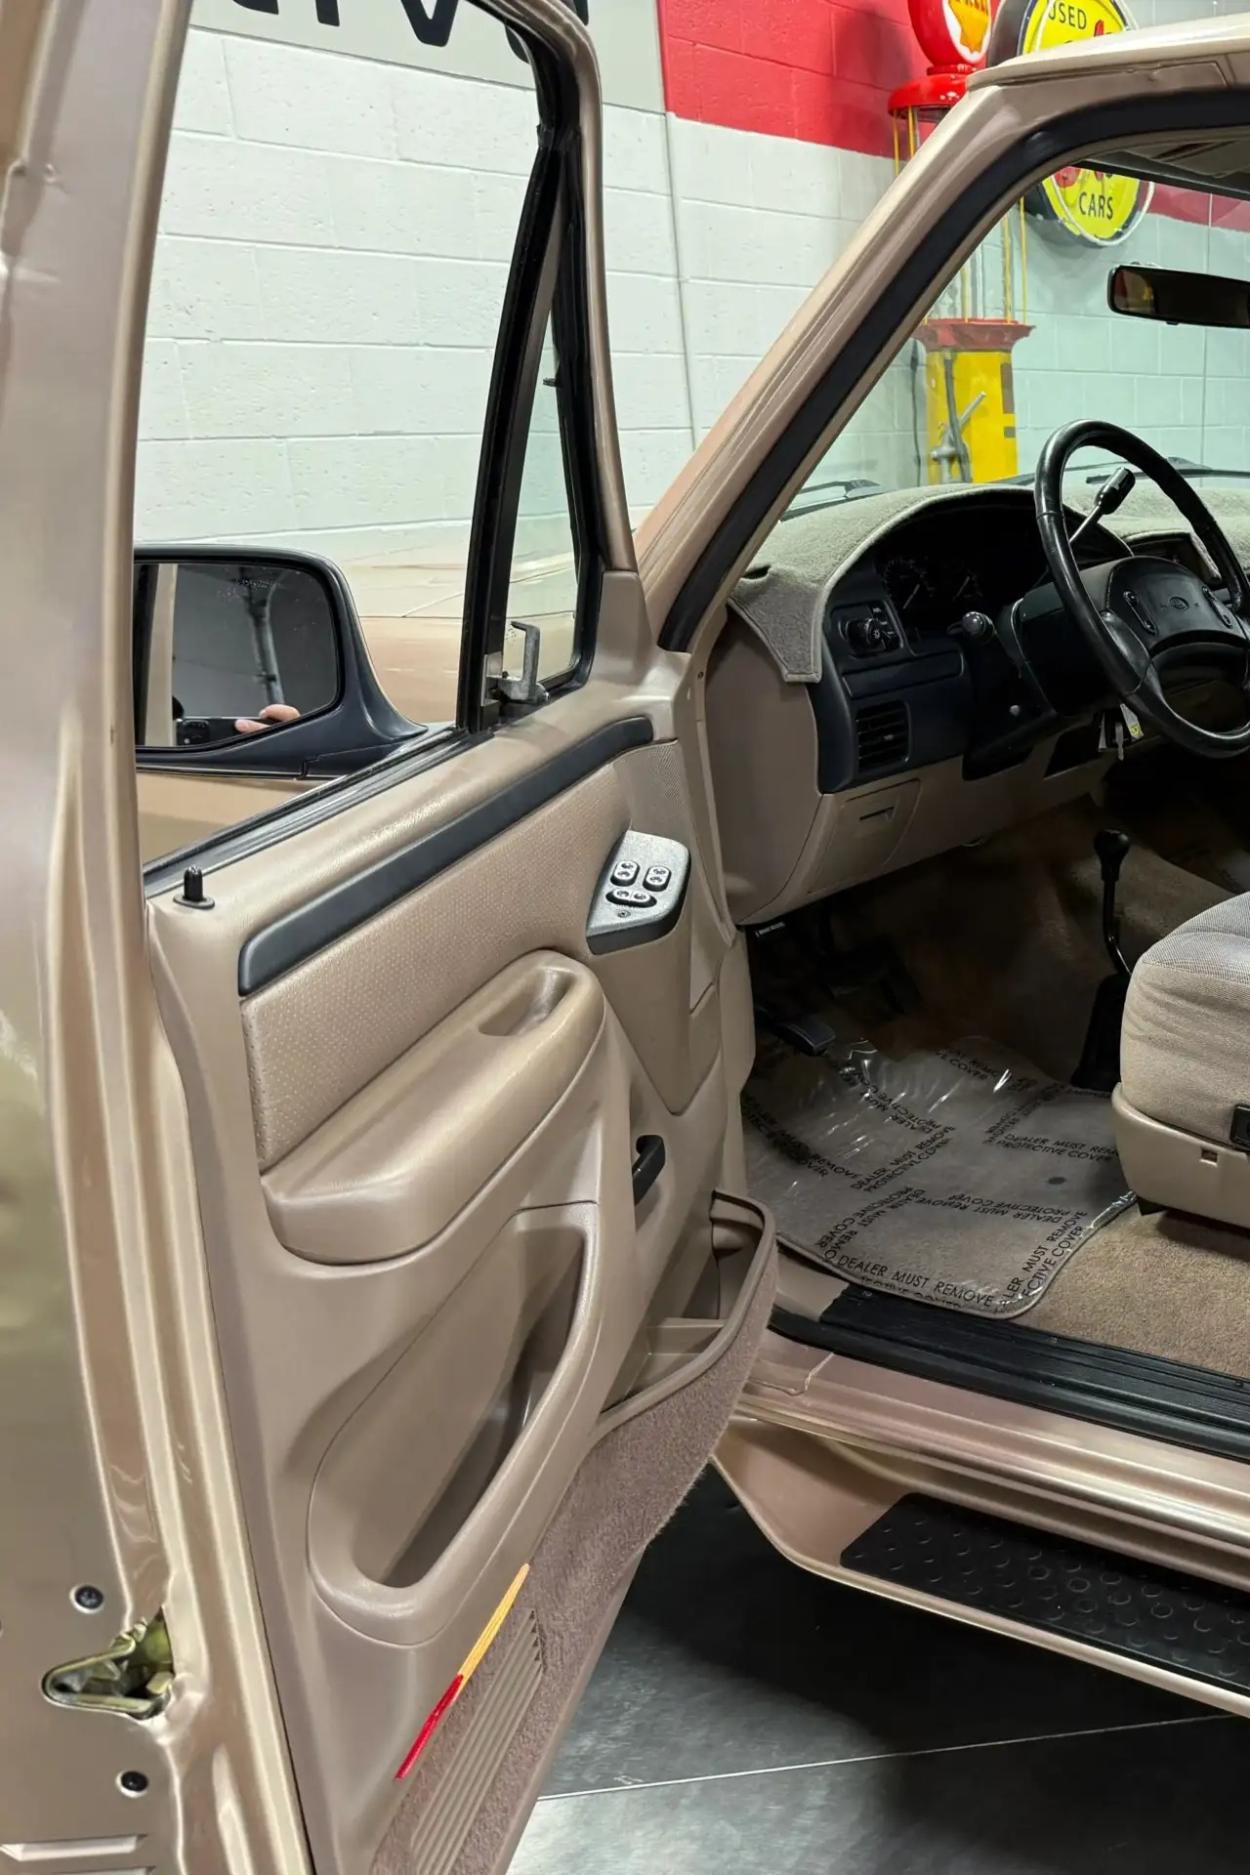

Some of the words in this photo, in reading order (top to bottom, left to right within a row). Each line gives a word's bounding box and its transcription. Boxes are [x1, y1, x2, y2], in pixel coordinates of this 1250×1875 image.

[1048, 0, 1086, 30] USED
[1079, 192, 1114, 220] CARS
[996, 1139, 1067, 1156] PROTECTIVE
[1003, 1133, 1049, 1145] DEALER
[1052, 1138, 1087, 1150] MUST
[849, 1167, 889, 1190] DEALER
[889, 1150, 916, 1166] MUST
[914, 1126, 957, 1150] REMOVE
[862, 1158, 921, 1193] PROTECTIVE
[914, 1196, 969, 1211] REMOVE
[947, 1192, 994, 1206] COVER
[971, 1205, 1008, 1216] MUST
[993, 1201, 1071, 1216] PROTECTIVE
[856, 1209, 886, 1228] MUST
[1011, 1210, 1063, 1224] DEALER
[814, 1216, 846, 1249] COVER
[1021, 1245, 1049, 1273] MUST
[1045, 1211, 1088, 1242] REMOVE
[1051, 1225, 1083, 1257] COVER
[837, 1255, 889, 1277] DEALER
[891, 1270, 929, 1290] MUST
[934, 1280, 994, 1307] REMOVE
